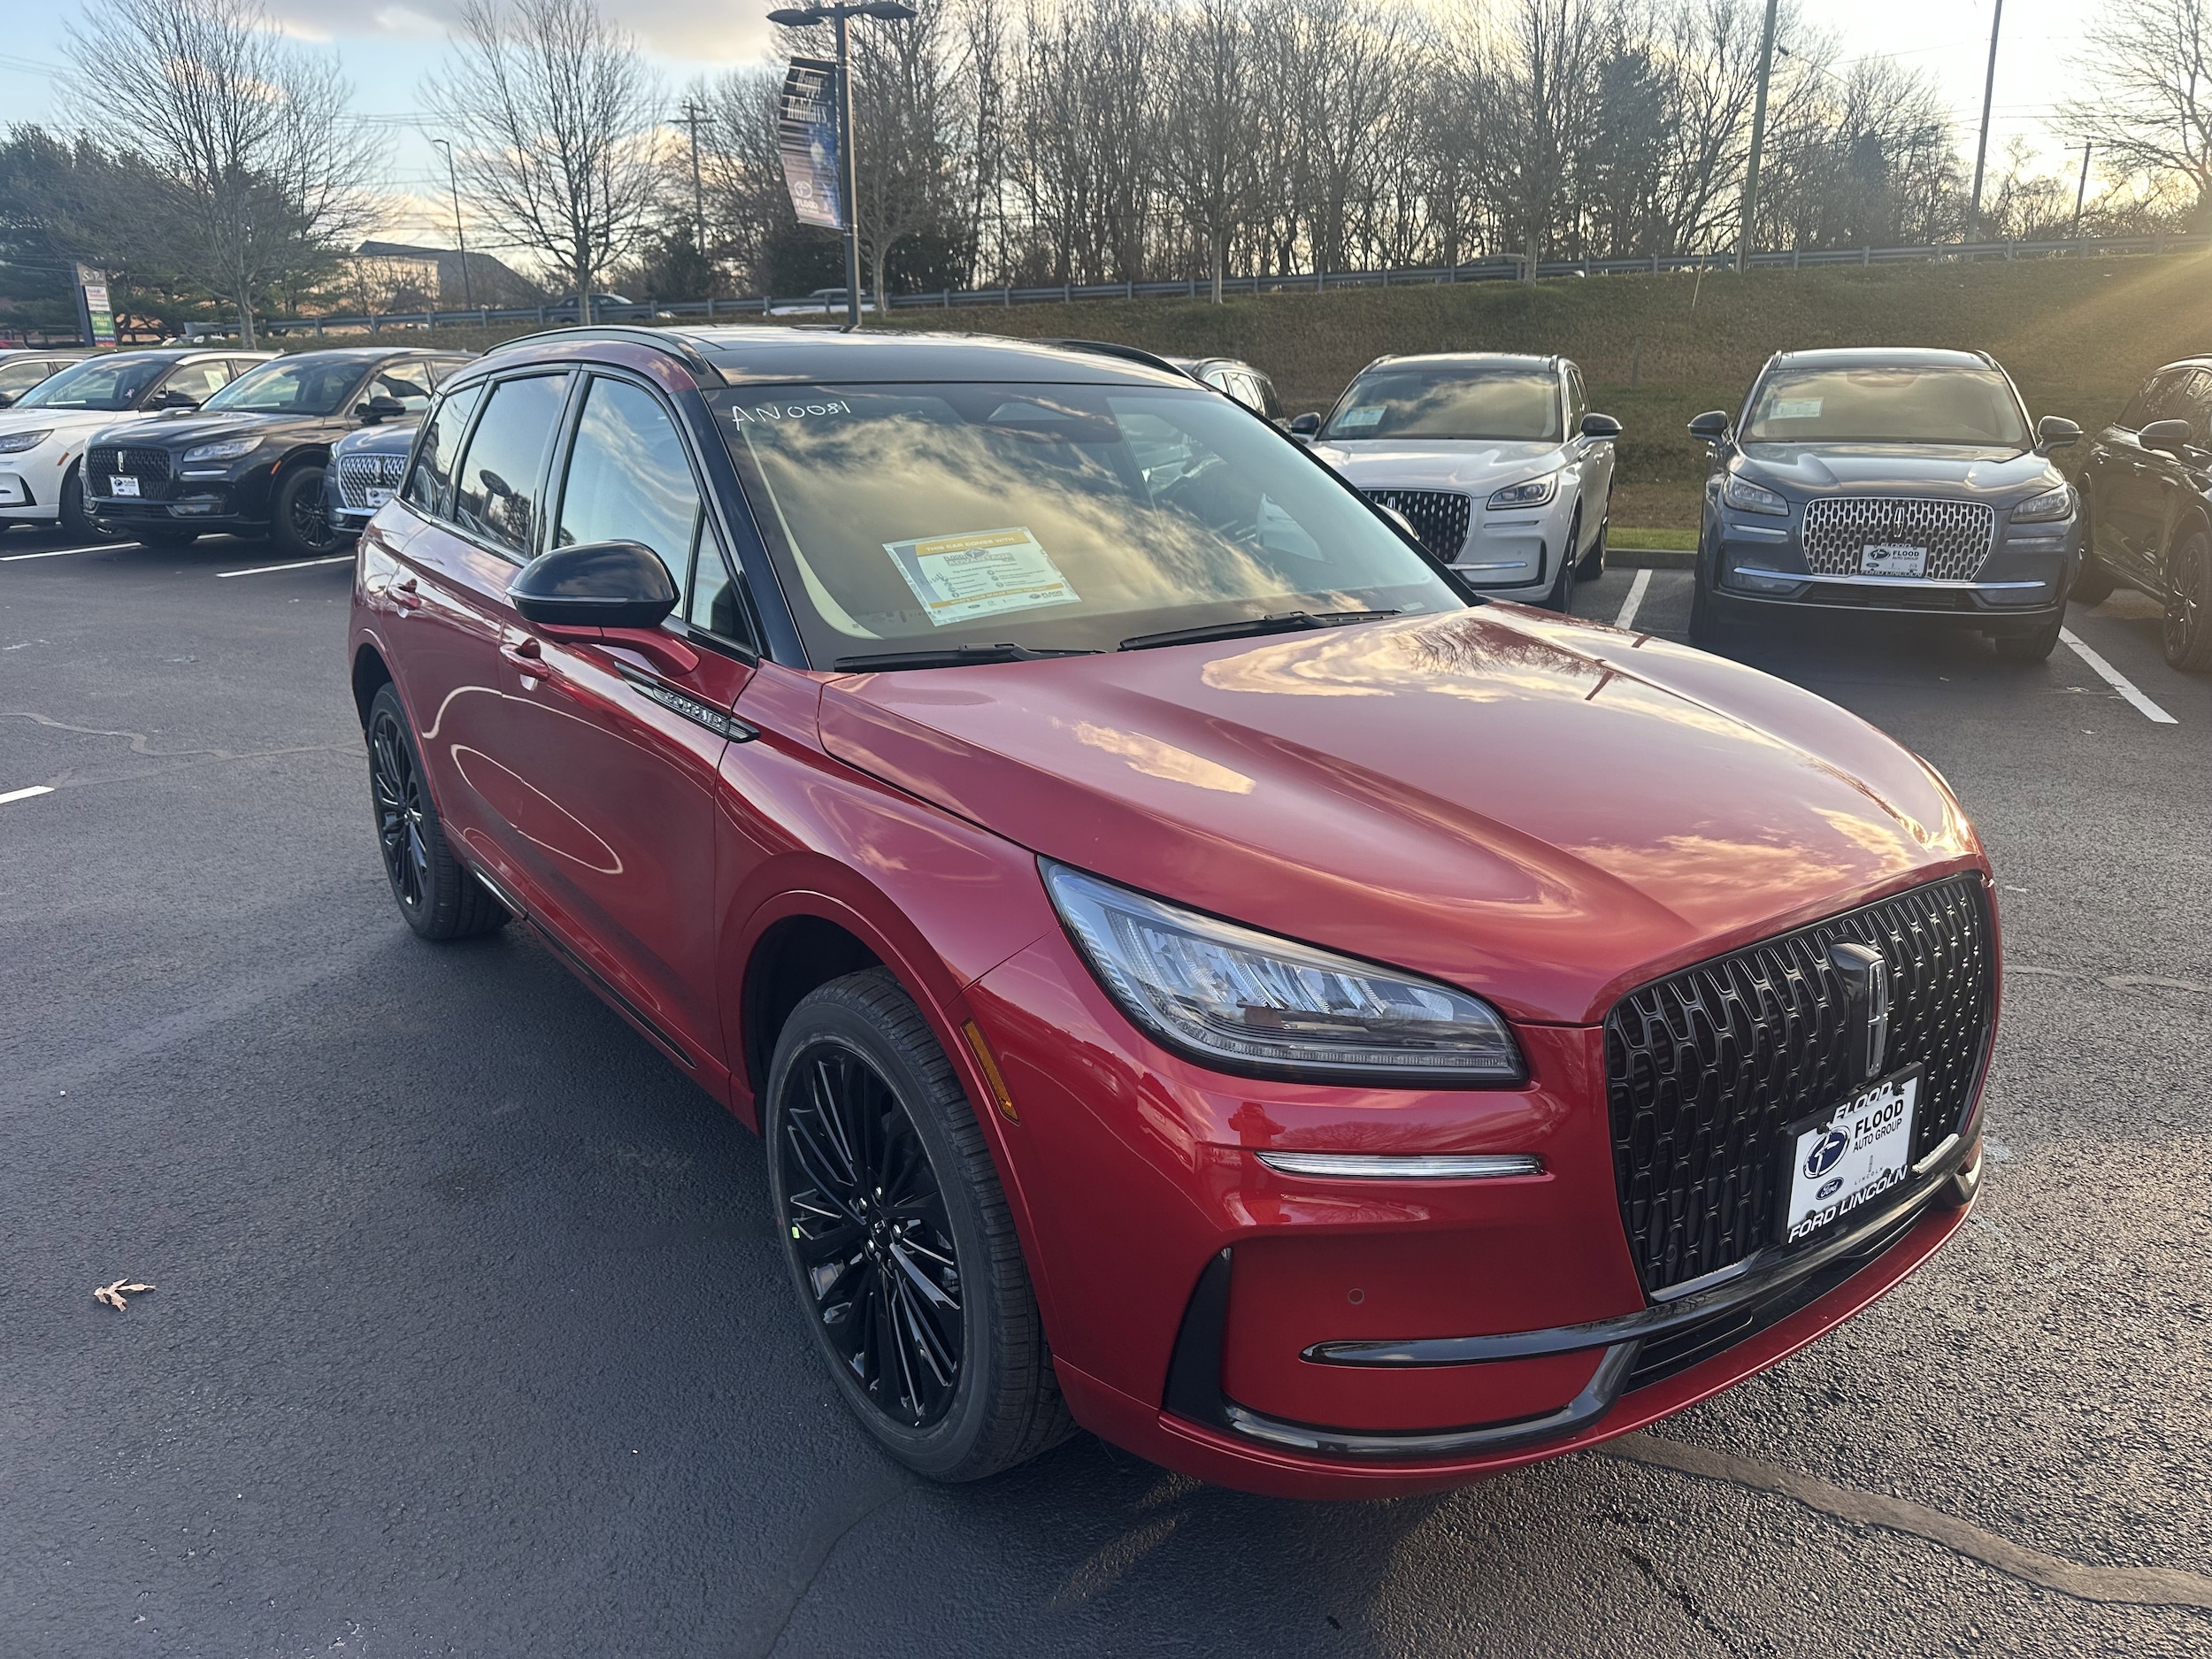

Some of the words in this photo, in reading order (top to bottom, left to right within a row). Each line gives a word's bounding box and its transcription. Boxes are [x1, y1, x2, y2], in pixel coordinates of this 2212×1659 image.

[787, 96, 827, 123] Holidays
[948, 553, 1014, 566] ADVANTAGE
[1832, 1080, 1893, 1125] FLOOD
[1855, 1098, 1904, 1139] FLOOD
[1853, 1133, 1874, 1154] AUTO
[1875, 1118, 1902, 1141] GROUP
[1854, 1165, 1884, 1187] LINCOLN
[1787, 1205, 1837, 1244] FORD
[1839, 1164, 1909, 1216] LINCOLN
